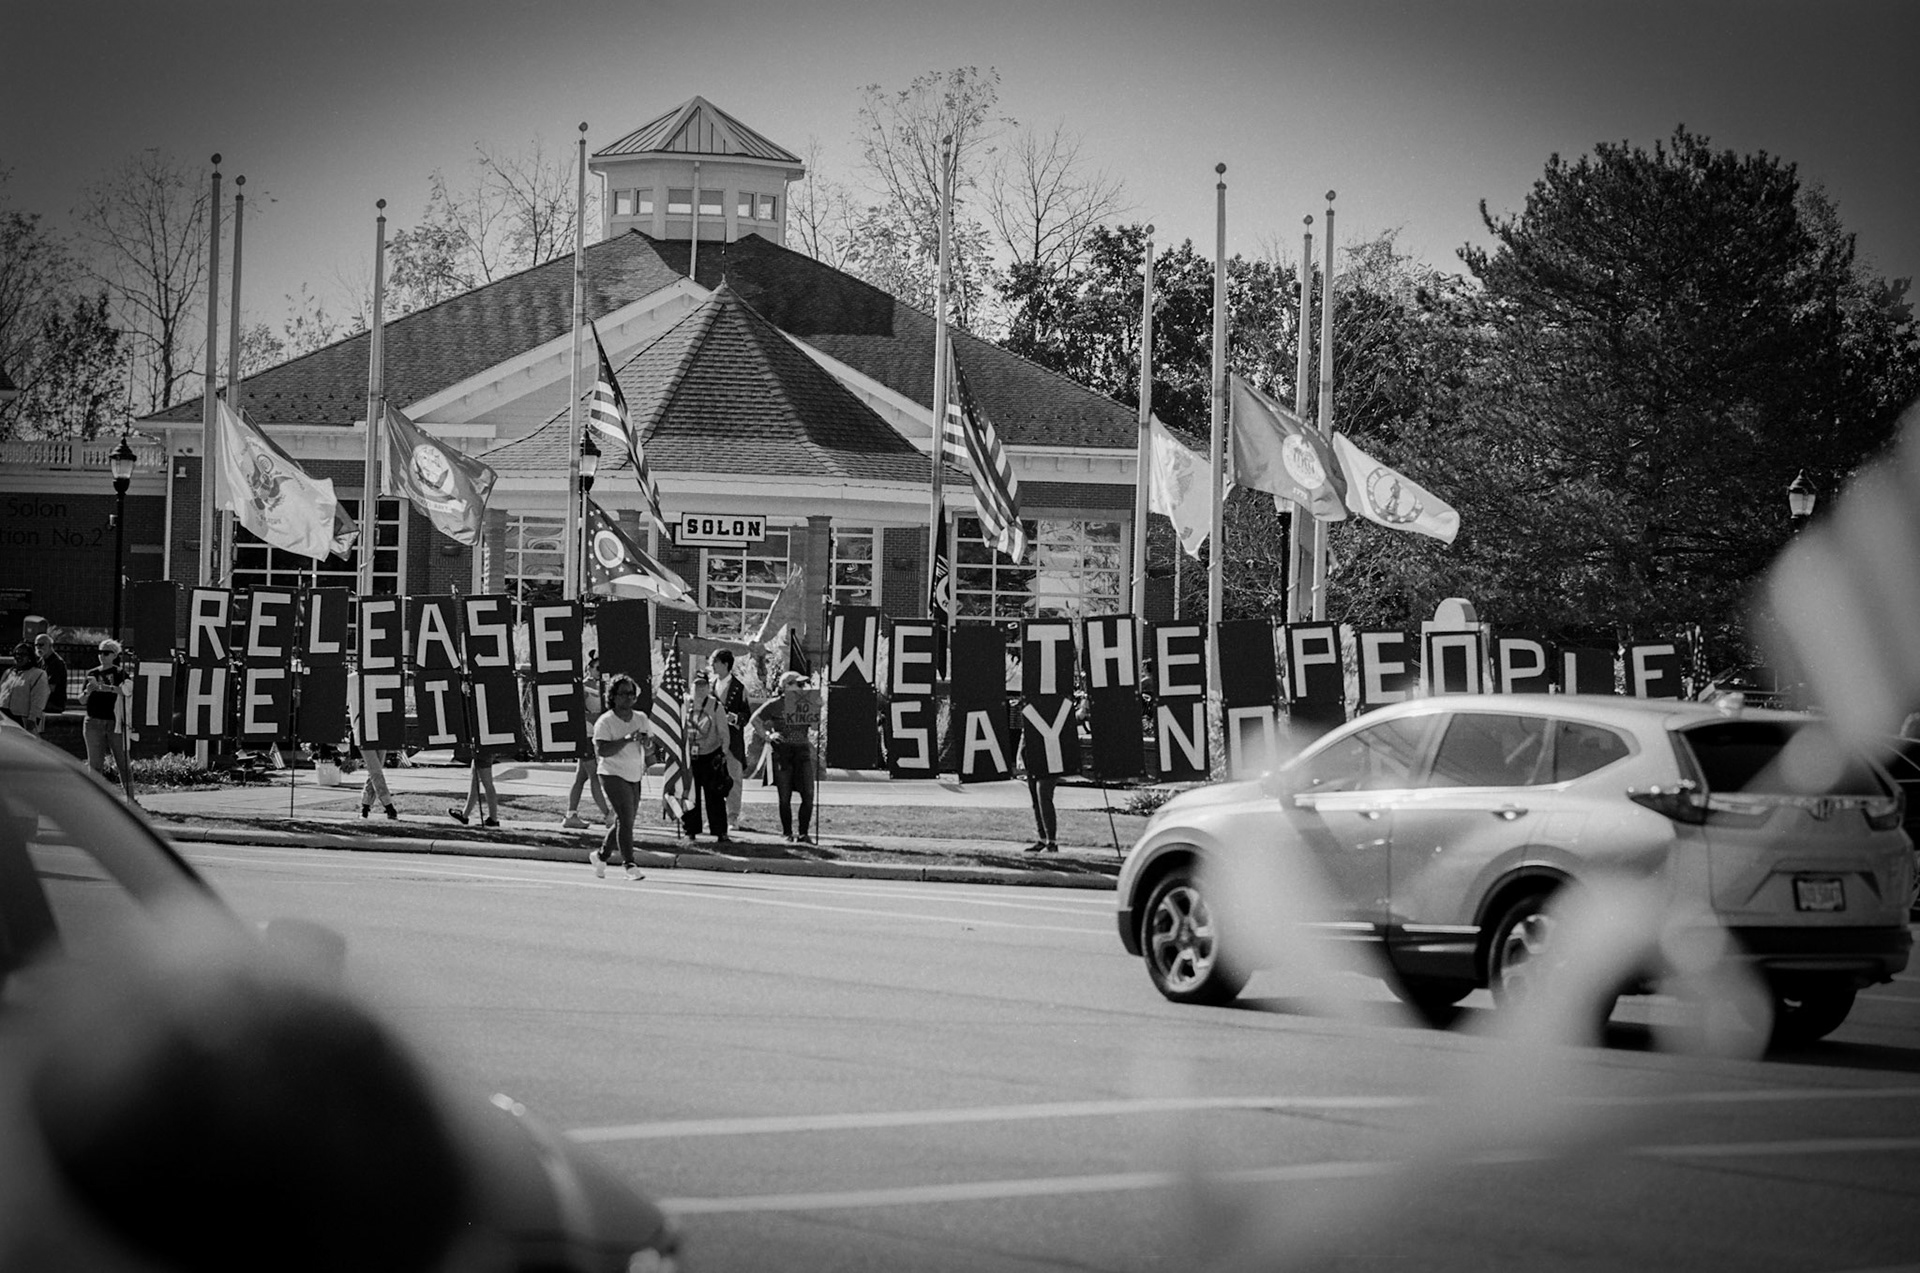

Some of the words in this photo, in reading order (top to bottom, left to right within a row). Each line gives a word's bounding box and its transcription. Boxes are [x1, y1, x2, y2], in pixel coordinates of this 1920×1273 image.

[8, 497, 67, 517] Solon
[687, 518, 761, 536] SOLON
[189, 590, 573, 673] RELEASE
[832, 615, 933, 694] WE
[1026, 620, 1201, 696] THE
[138, 662, 285, 735] THE
[364, 674, 577, 752] FILE
[785, 712, 820, 723] KINGS
[796, 703, 809, 712] NO
[890, 698, 1072, 774] SAY
